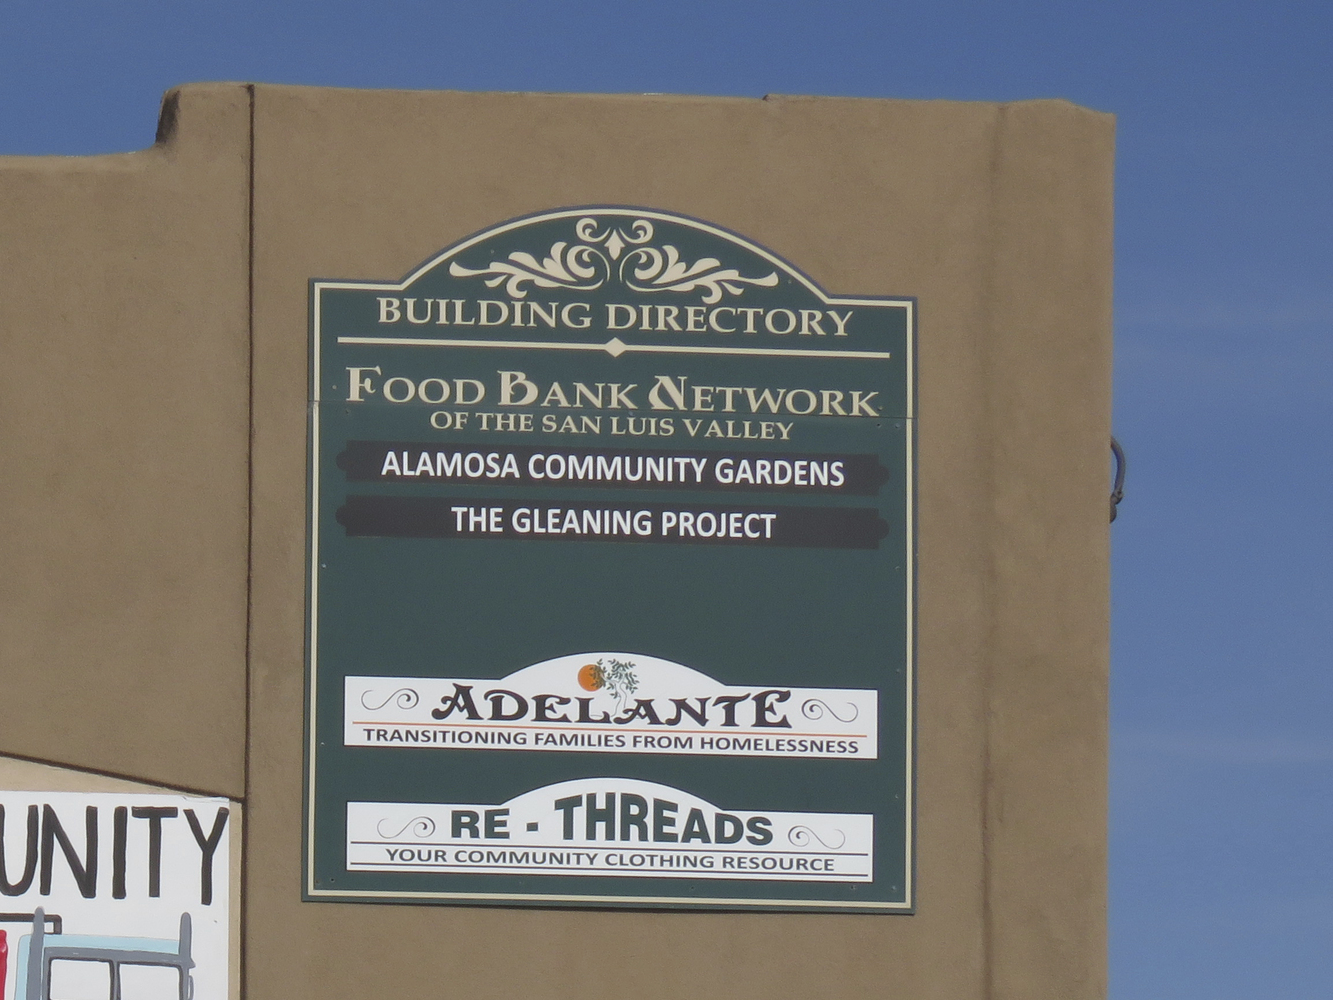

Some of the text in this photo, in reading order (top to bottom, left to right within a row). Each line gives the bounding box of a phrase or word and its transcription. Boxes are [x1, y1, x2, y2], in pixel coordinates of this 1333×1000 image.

[377, 297, 853, 337] BUILDING DIRECTORY
[429, 411, 794, 440] OF THE SAN LUIS VALLEY
[382, 450, 845, 486] ALAMOSA COMMUNITY GARDENS
[452, 506, 776, 538] THE GLEANING PROJECT
[431, 683, 792, 728] ADELANTE
[363, 728, 858, 754] TRANSITIONING FAMILIES FROM HOMELESSNESS
[451, 808, 511, 839] RE
[554, 792, 773, 846] THREADS
[386, 848, 835, 872] YOUR COMMUNITY CLOTHING RESOURCE
